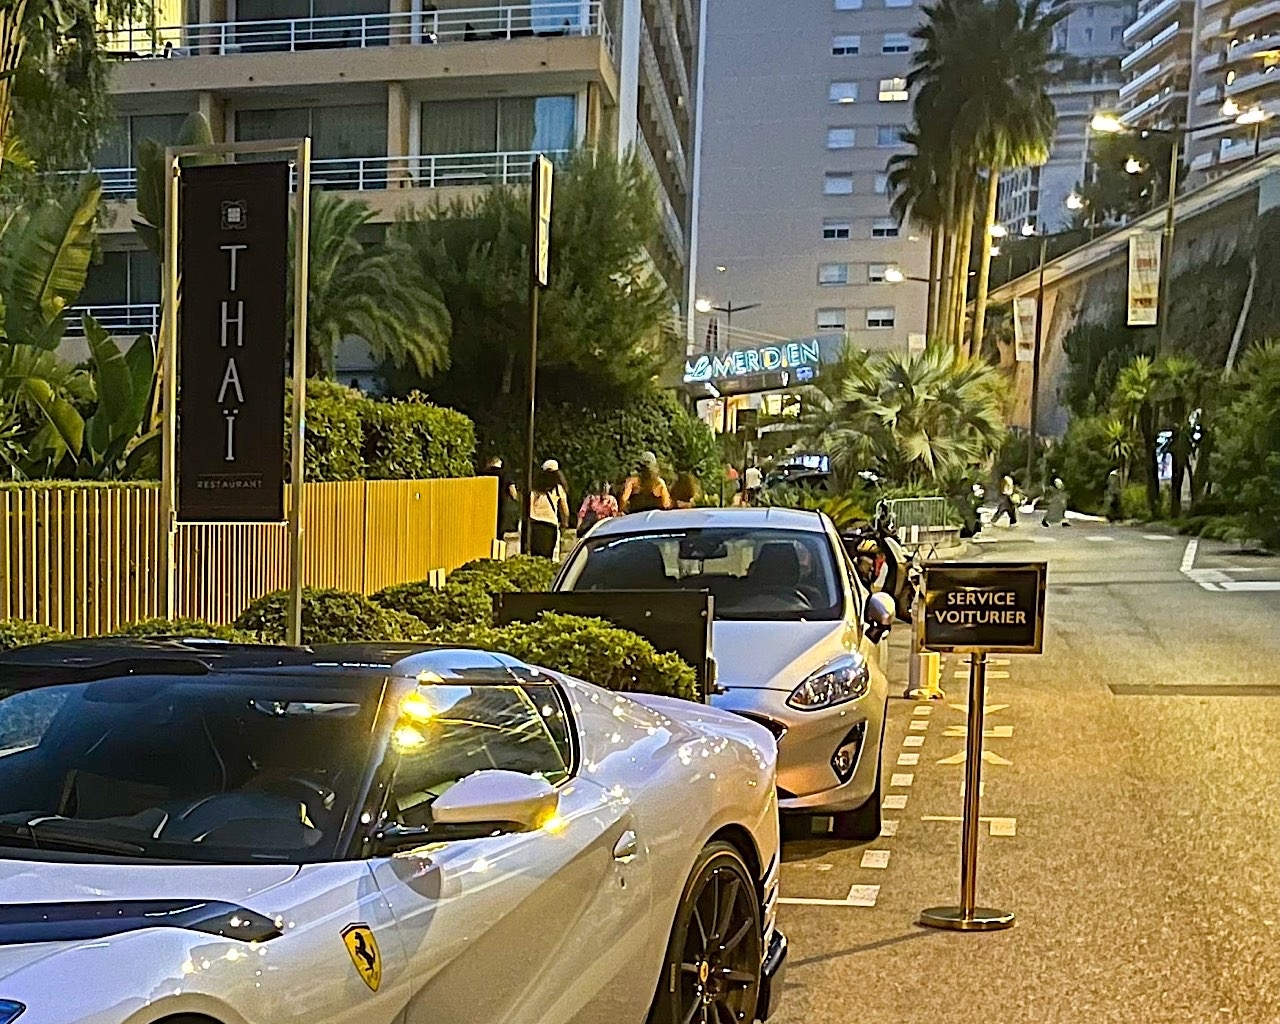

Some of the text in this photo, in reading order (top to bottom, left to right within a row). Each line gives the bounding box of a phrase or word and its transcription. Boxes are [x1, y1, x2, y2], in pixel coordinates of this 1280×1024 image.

[217, 244, 248, 461] THAÏ
[196, 480, 263, 489] RESTAURANT
[947, 592, 1016, 606] SERVICE
[935, 610, 1027, 624] VOITURIER
